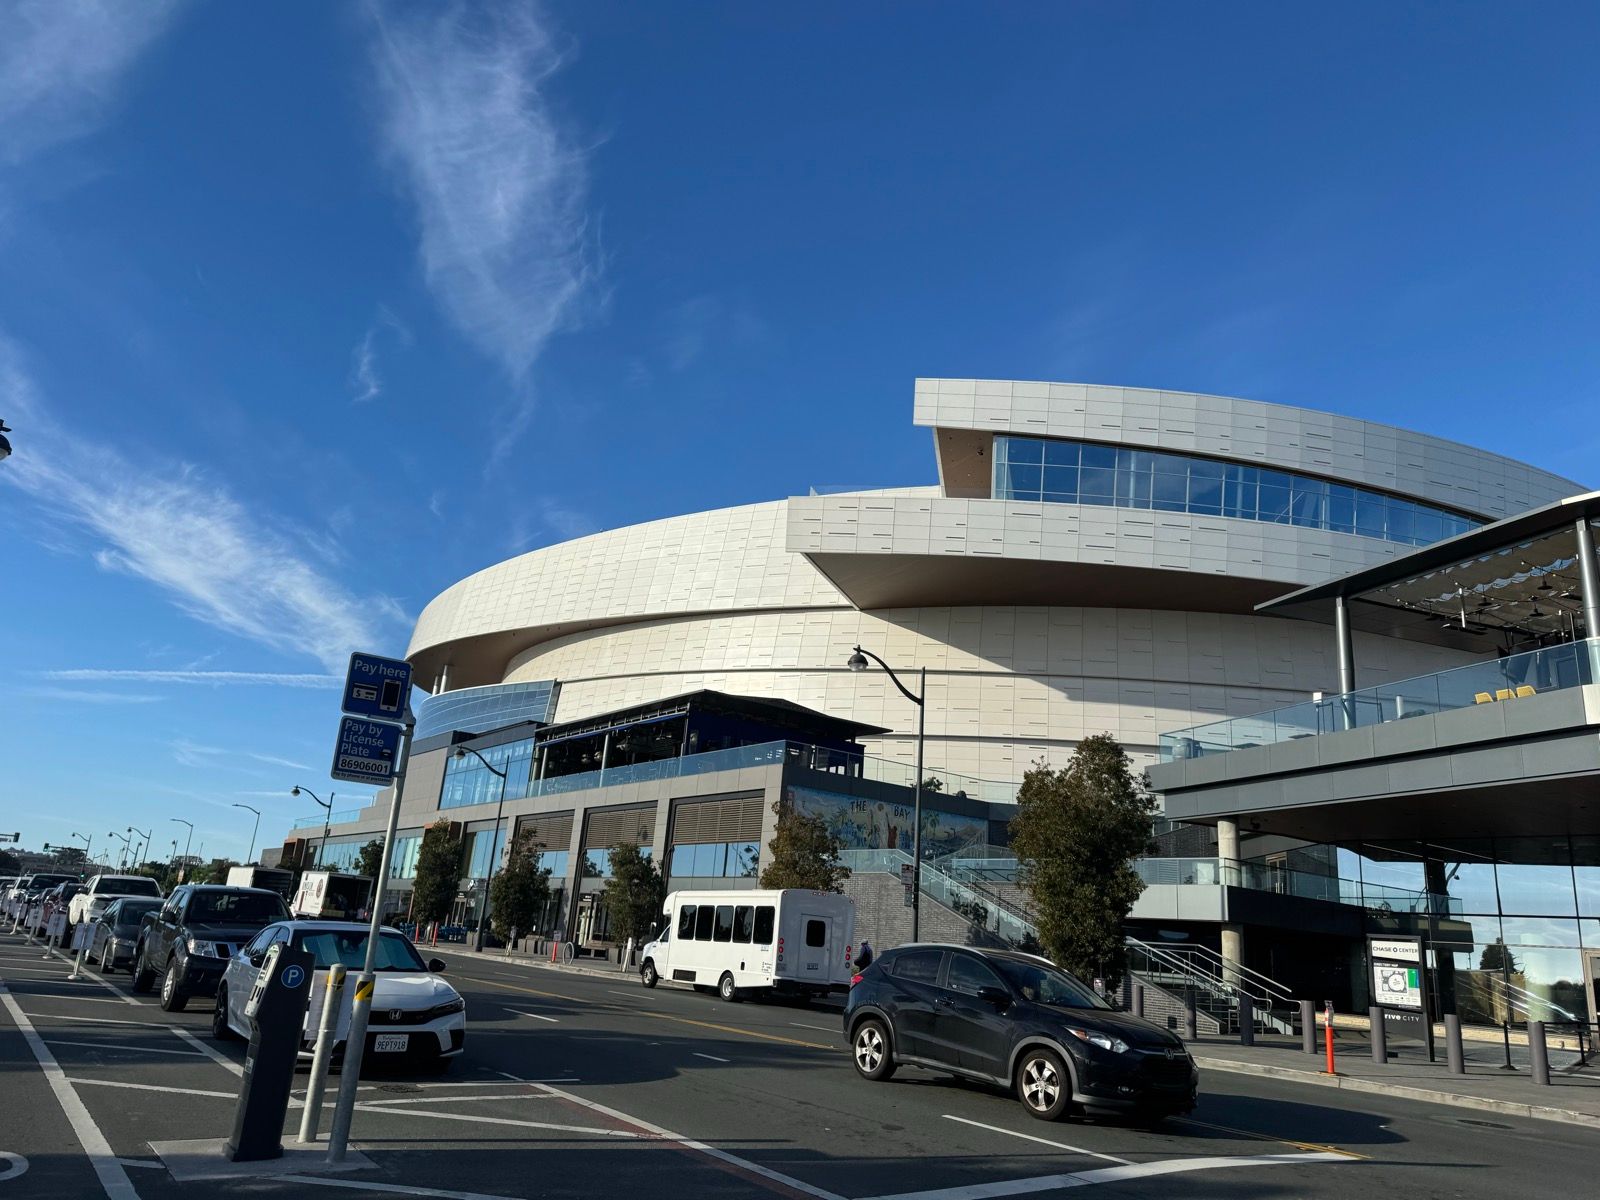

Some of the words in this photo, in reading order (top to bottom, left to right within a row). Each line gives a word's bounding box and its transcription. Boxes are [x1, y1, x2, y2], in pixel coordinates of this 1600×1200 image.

[354, 660, 378, 676] Pay
[379, 664, 407, 679] here
[345, 719, 366, 735] Pay
[369, 724, 383, 737] by
[343, 732, 384, 747] License
[341, 742, 370, 757] Plate
[340, 758, 389, 774] 86906001
[850, 801, 867, 812] THE
[894, 805, 910, 819] BAY
[288, 970, 299, 984] P
[376, 1040, 406, 1050] 9EPT918
